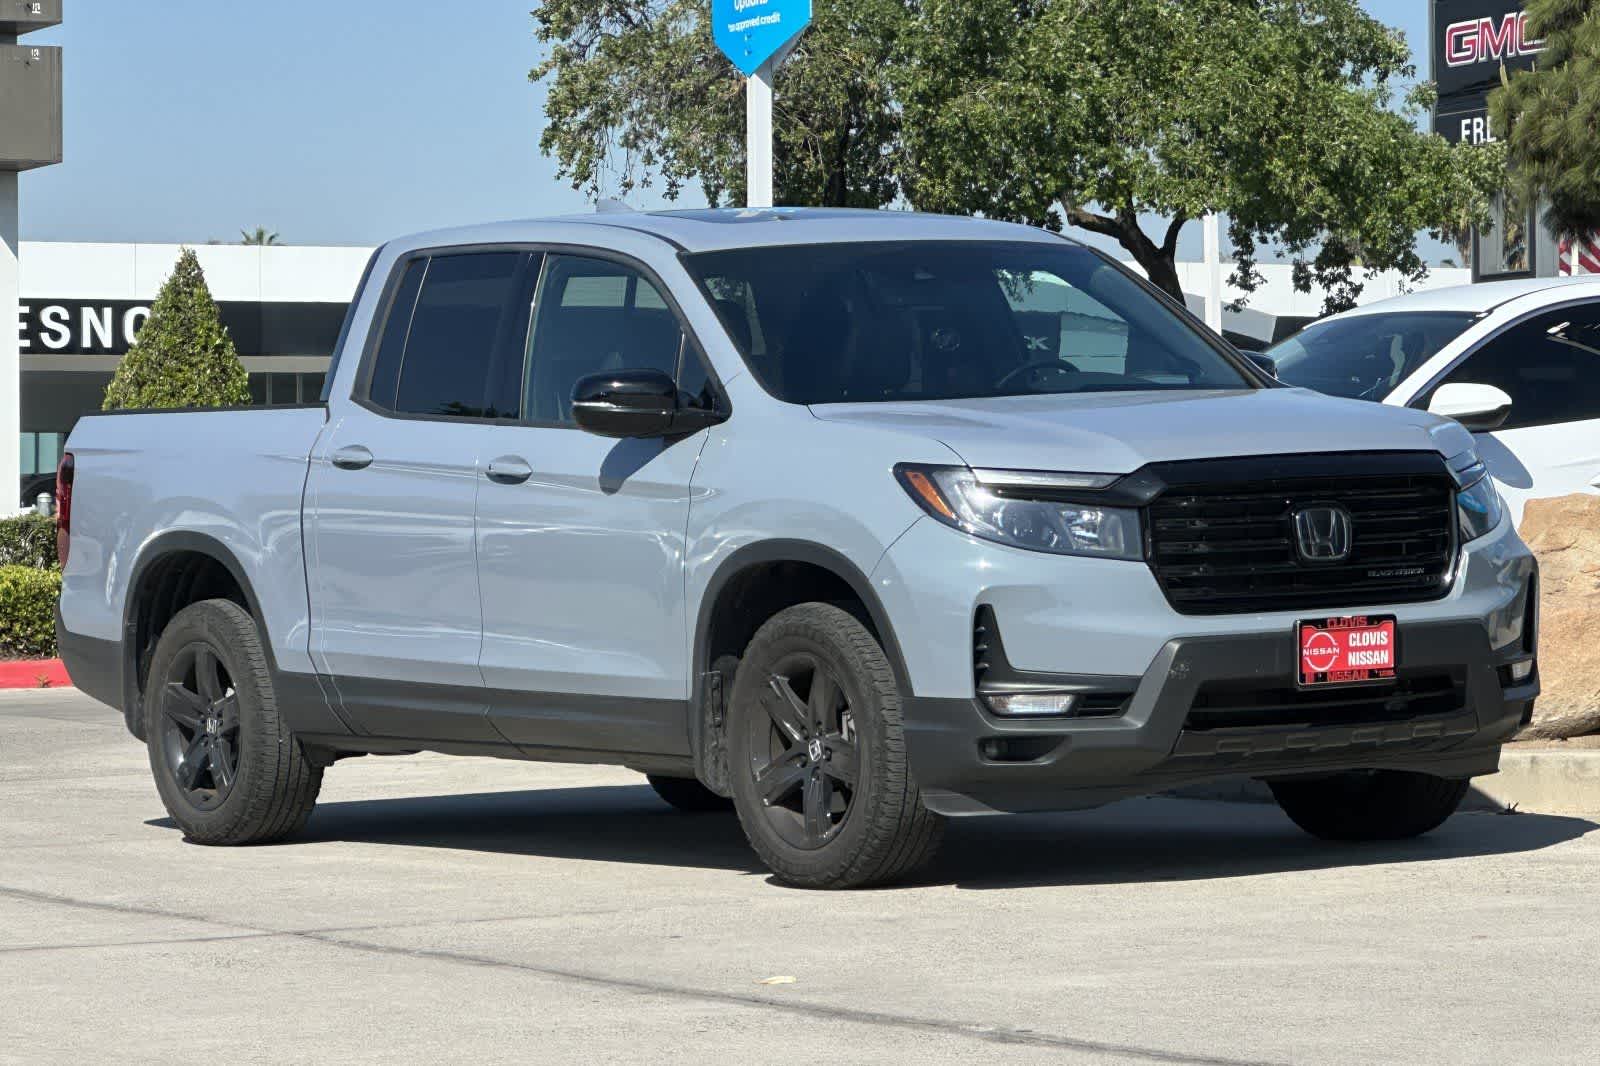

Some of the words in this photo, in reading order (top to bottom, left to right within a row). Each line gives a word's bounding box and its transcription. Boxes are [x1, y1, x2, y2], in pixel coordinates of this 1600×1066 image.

[760, 11, 781, 25] credit
[1327, 616, 1367, 628] CLOVIS
[1348, 630, 1388, 647] CLOVIS
[1302, 646, 1340, 657] NISSAN
[1347, 649, 1389, 667] NISSAN
[1327, 669, 1369, 682] NISSAN
